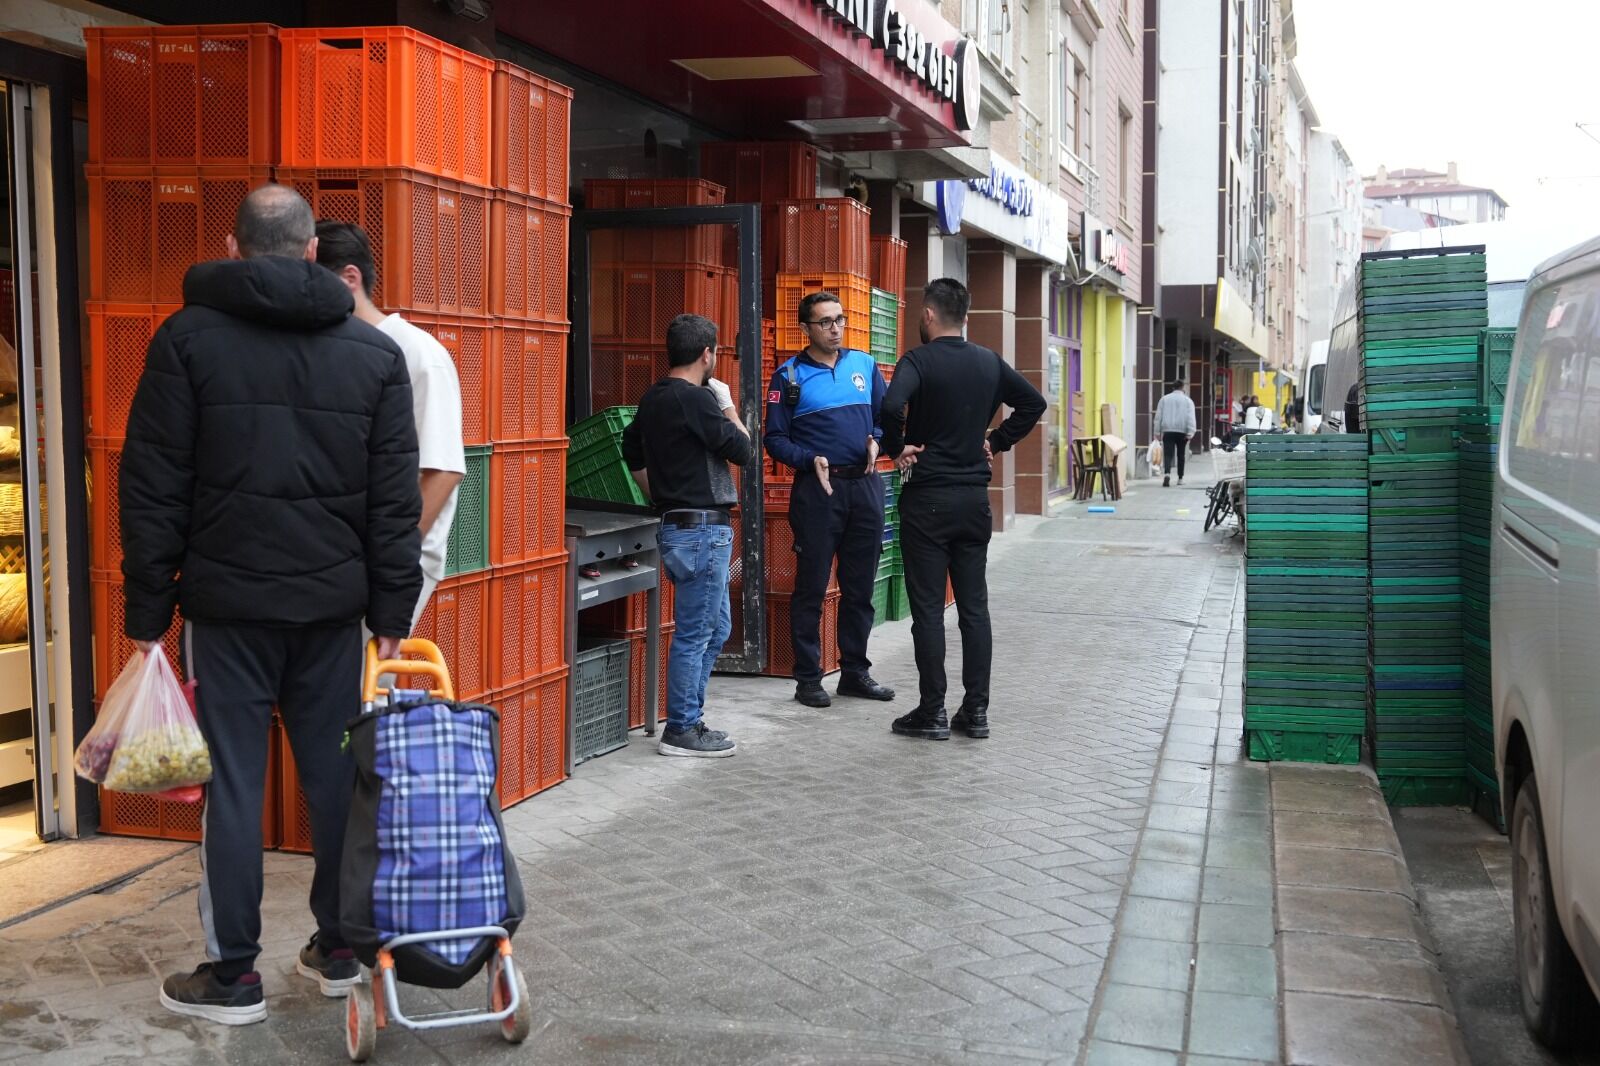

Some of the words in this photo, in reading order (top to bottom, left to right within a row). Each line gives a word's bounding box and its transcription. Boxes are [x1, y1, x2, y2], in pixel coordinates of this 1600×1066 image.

[158, 44, 194, 53] TAT-AL
[896, 11, 927, 81] 322
[161, 185, 195, 194] TAT-AL
